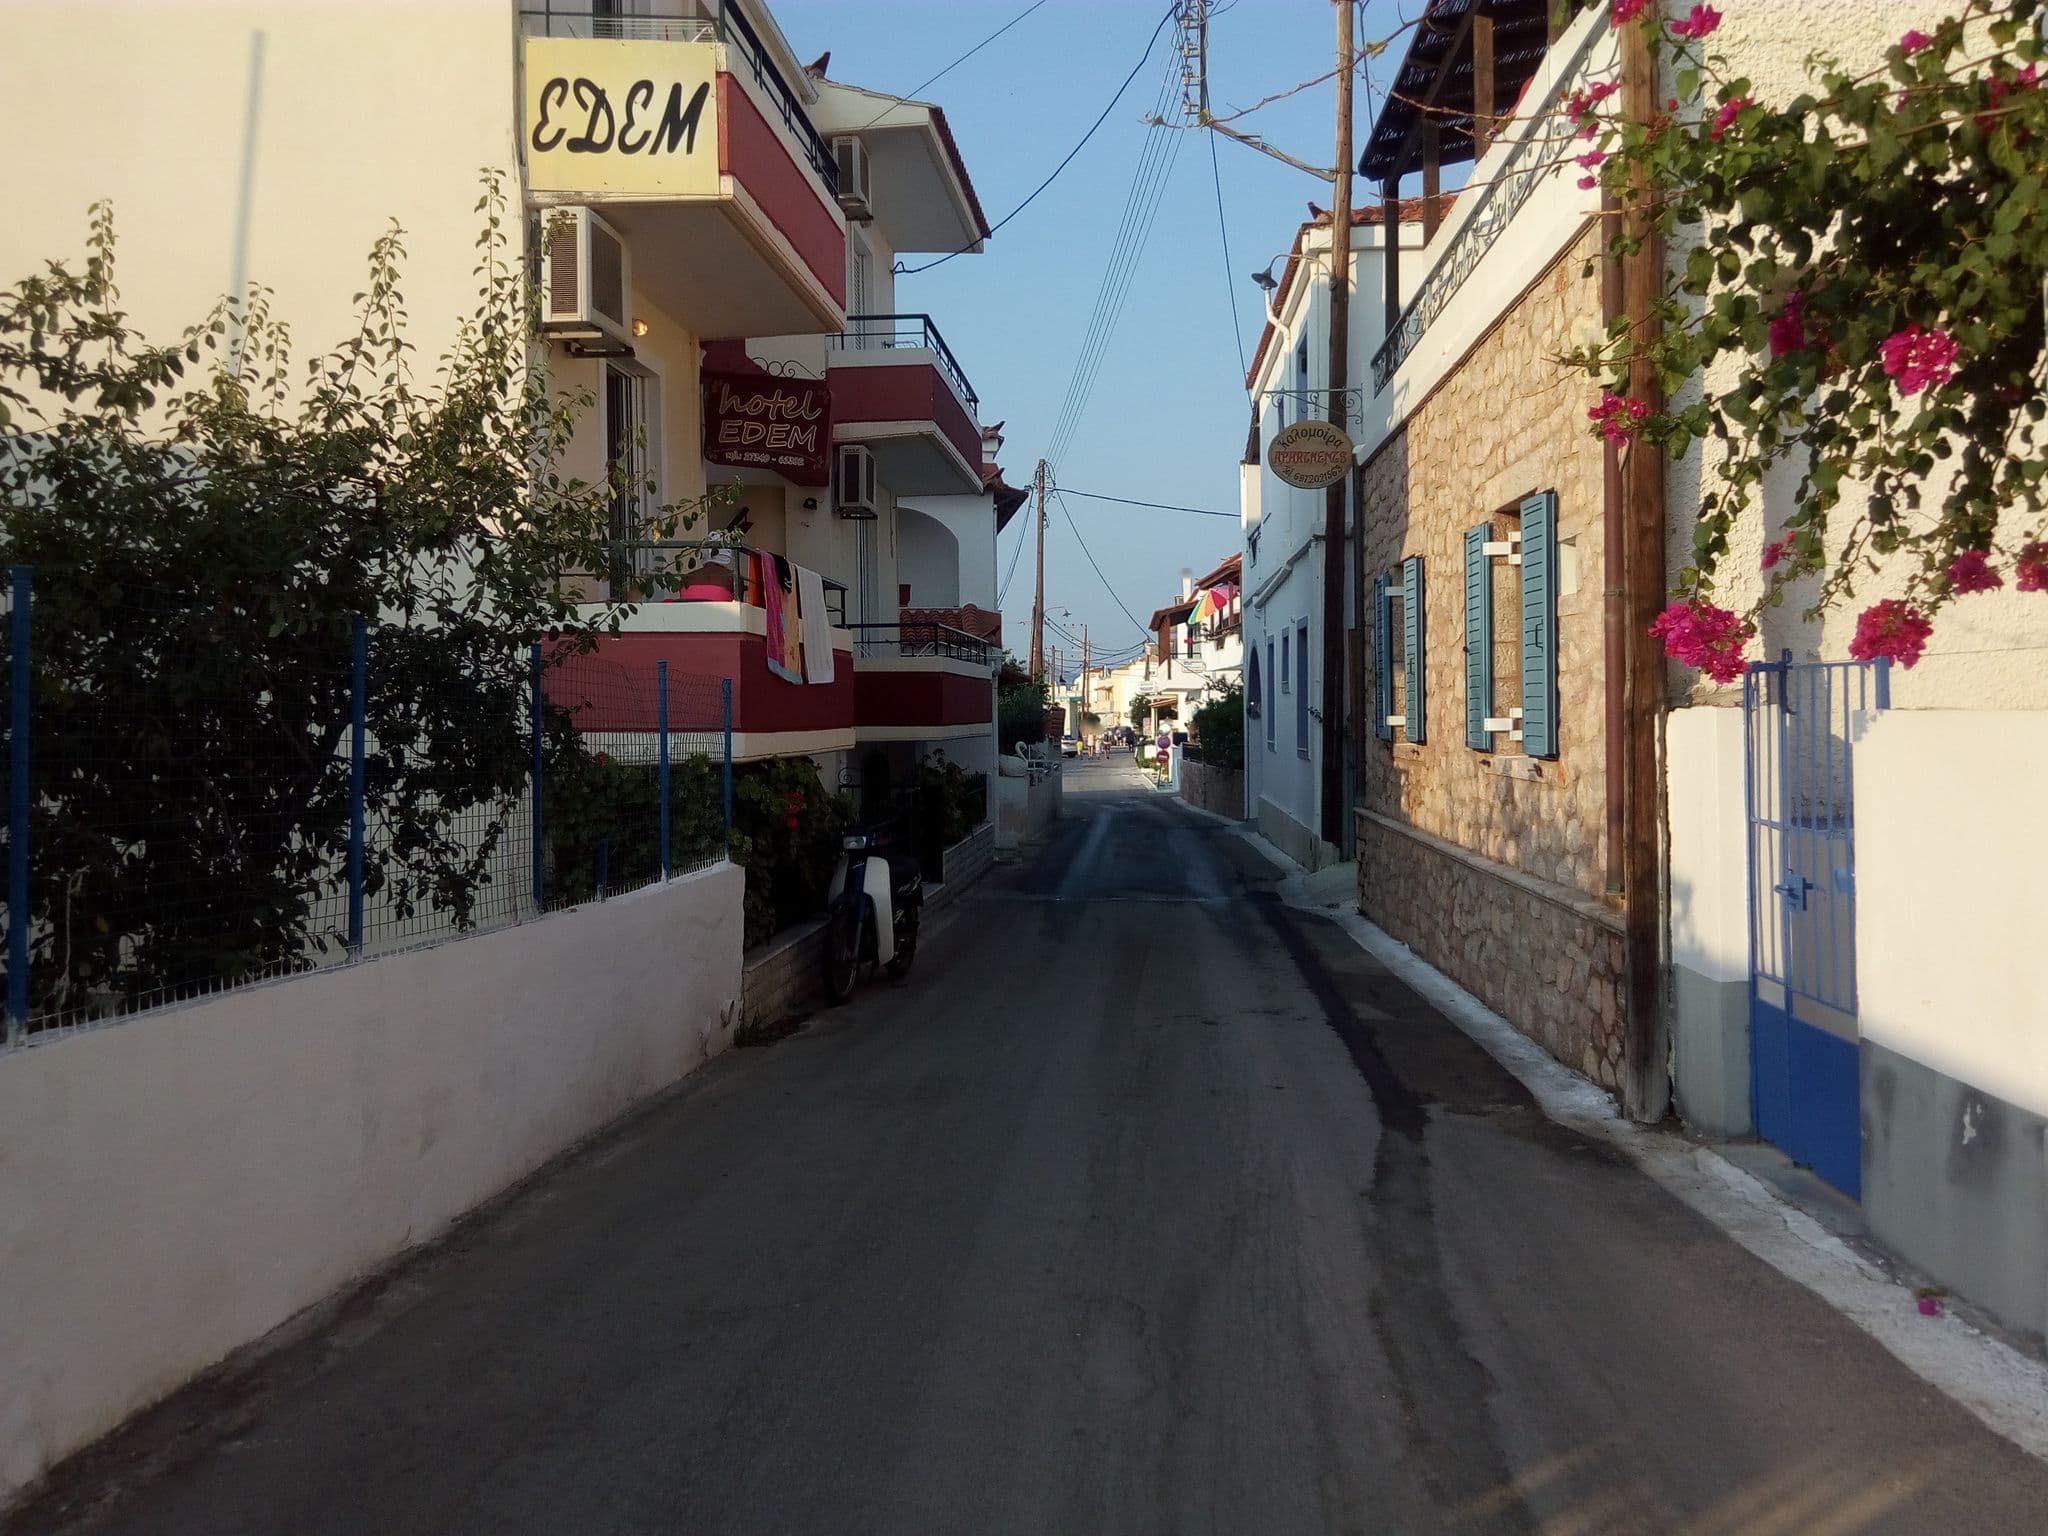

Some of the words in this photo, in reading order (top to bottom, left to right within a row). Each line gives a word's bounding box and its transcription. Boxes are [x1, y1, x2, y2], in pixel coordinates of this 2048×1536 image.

[532, 77, 710, 155] EDEM
[719, 384, 822, 420] hotel
[718, 420, 817, 452] EDEM
